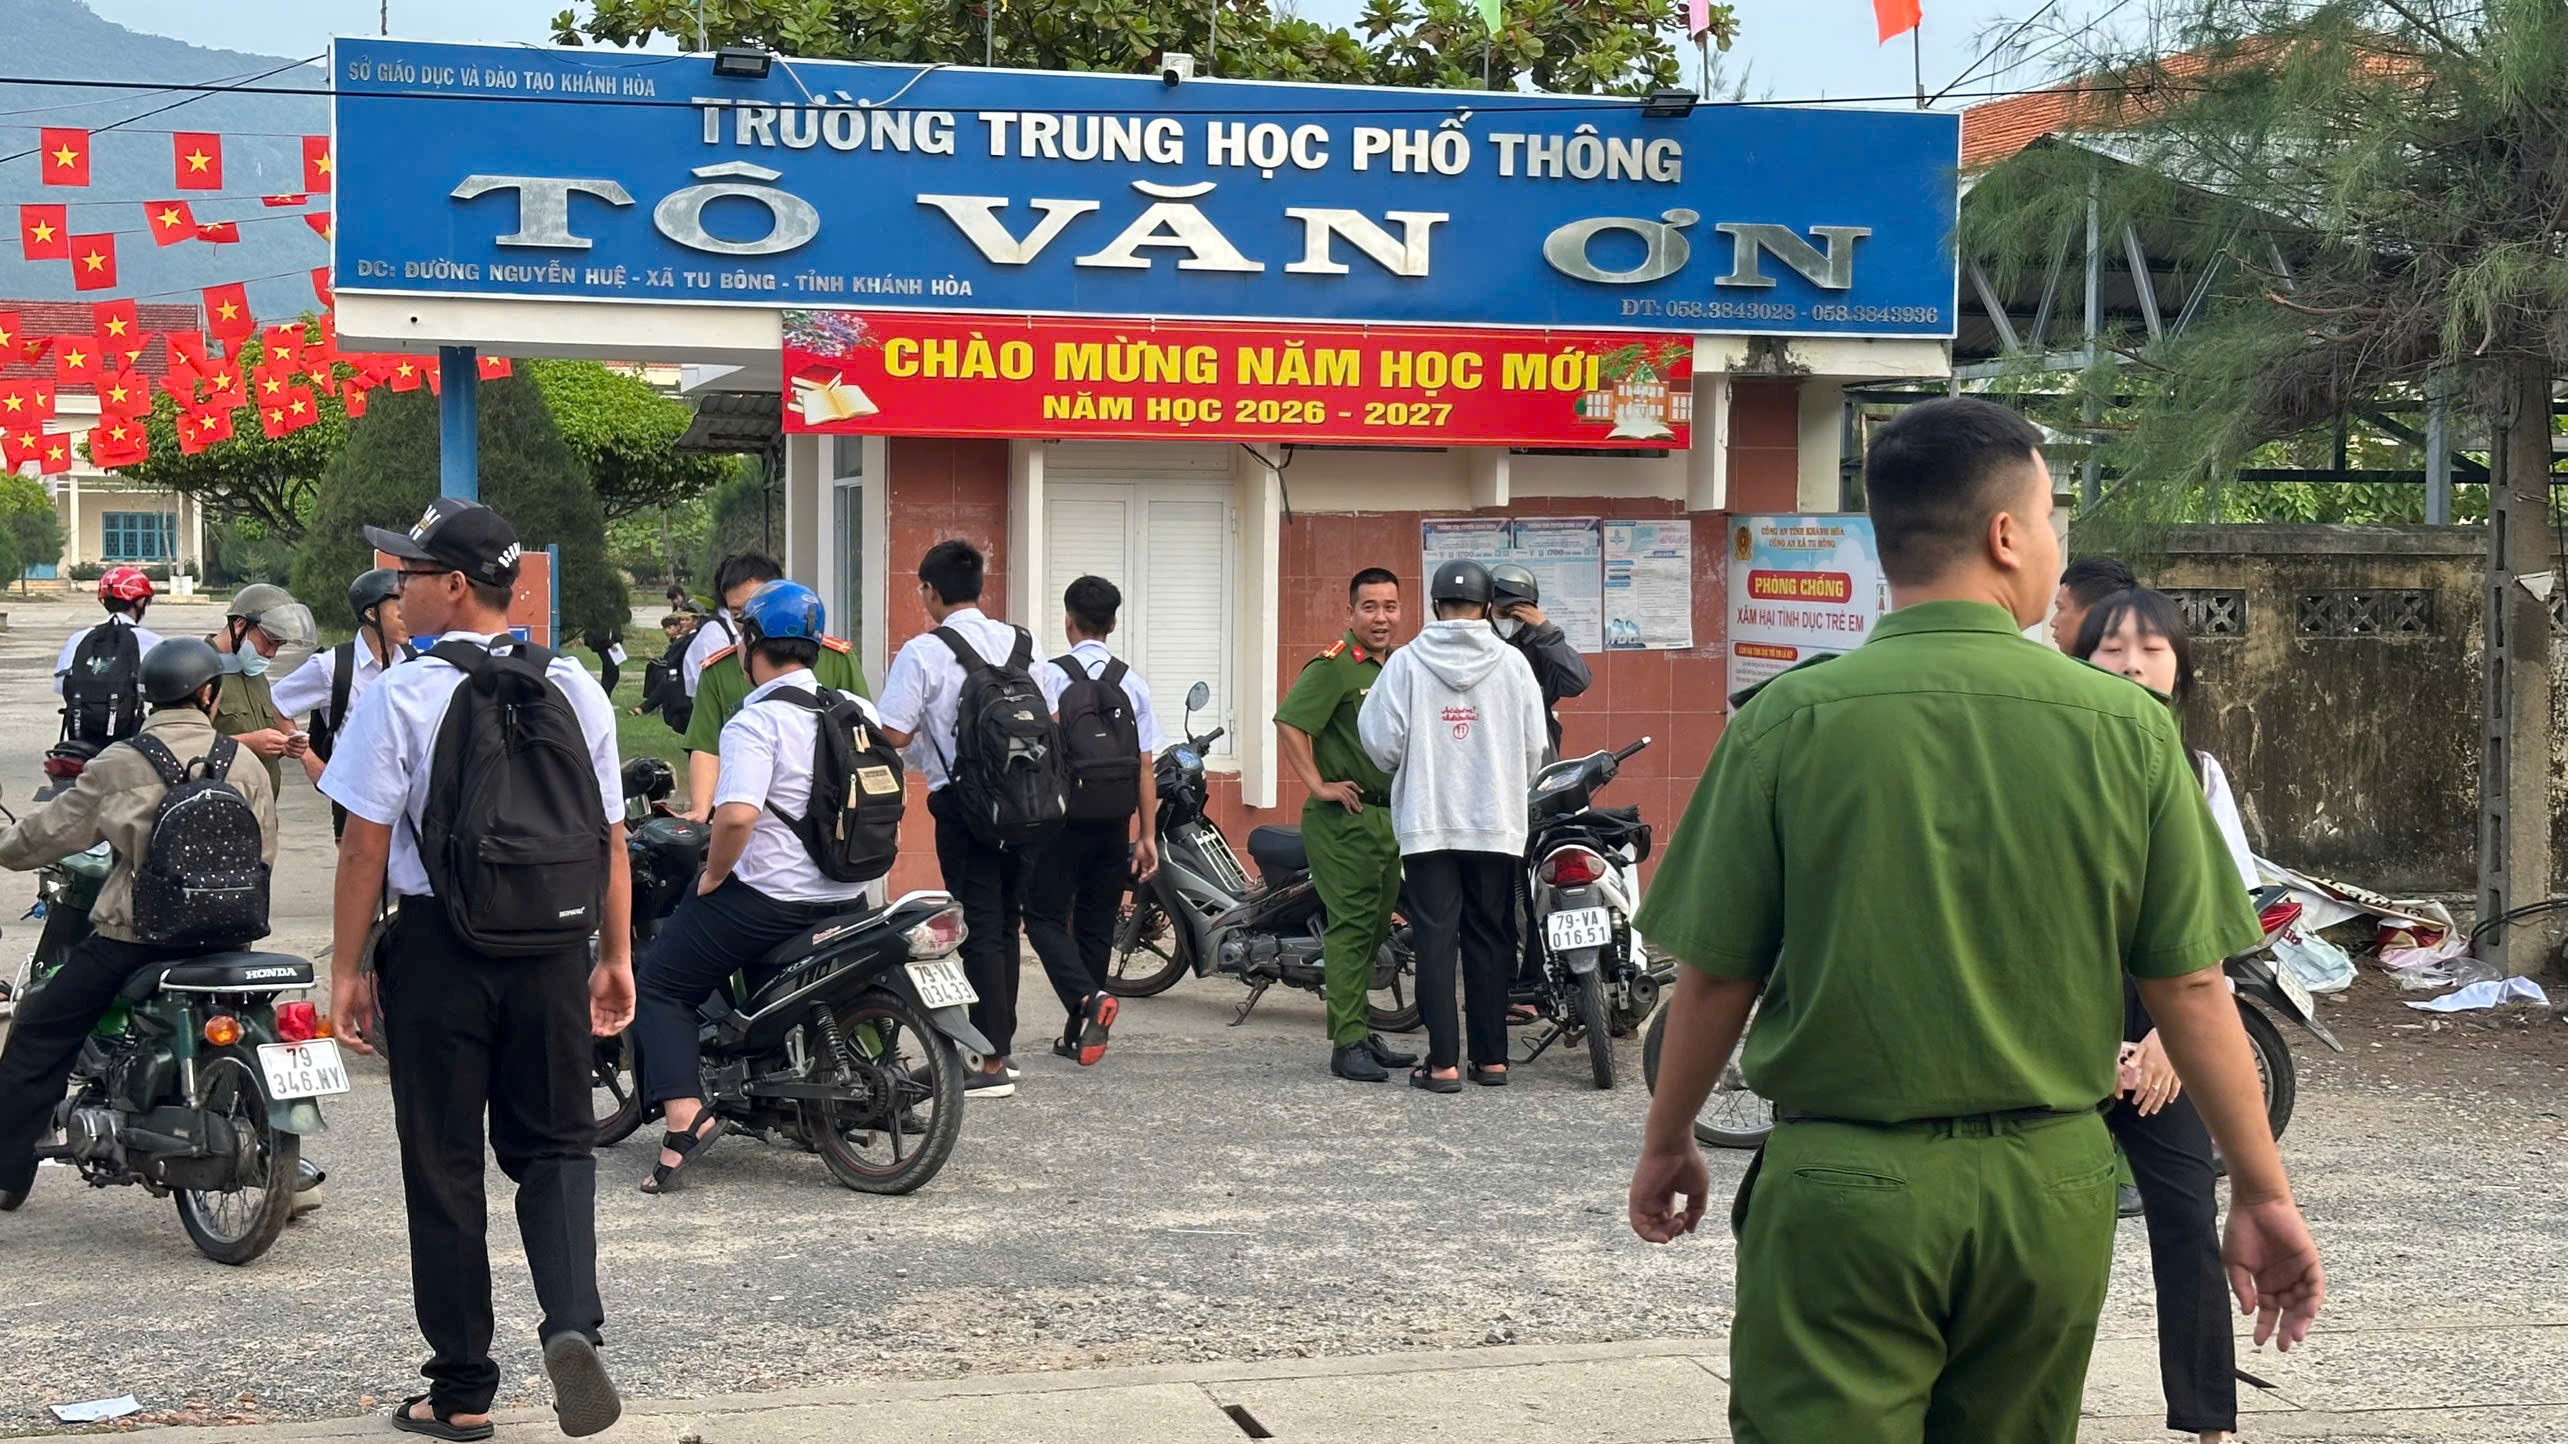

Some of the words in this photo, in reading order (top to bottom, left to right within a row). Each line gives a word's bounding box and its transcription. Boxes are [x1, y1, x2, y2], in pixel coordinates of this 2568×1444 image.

[348, 56, 371, 81] SỞ
[377, 60, 416, 83] GIÁO
[421, 65, 455, 89] DỤC
[461, 64, 480, 87] VÀ
[485, 63, 517, 88] ĐÀO
[523, 71, 555, 94] TẠO
[561, 70, 617, 95] KHÁNH
[623, 73, 656, 97] HÒA
[691, 90, 956, 155] TRƯỜNG
[978, 111, 1185, 165] TRUNG
[1207, 120, 1329, 179] HỌC
[1353, 105, 1472, 175] PHỐ
[1488, 123, 1682, 184] THÔNG
[449, 160, 821, 255] TÔ
[916, 179, 1450, 278] VĂN
[1542, 207, 1873, 289] ƠN
[357, 259, 396, 278] ĐC:
[404, 257, 480, 281] ĐƯỜNG
[489, 259, 576, 284] NGUYỄN
[585, 264, 627, 290] HUỆ
[646, 267, 675, 287] XÃ
[683, 271, 711, 289] TU
[720, 269, 776, 291] BÔNG
[794, 270, 844, 293] TỈNH
[853, 273, 923, 295] KHÁNH
[931, 273, 973, 297] HÒA
[1620, 298, 1662, 316] ĐT:
[1665, 299, 1796, 320] 058.3843028
[1811, 304, 1938, 324] 058.3843936
[884, 331, 1035, 381] CHÀO
[1055, 334, 1218, 385] MỪNG
[1237, 339, 1361, 387] NĂM
[1380, 349, 1484, 398] HỌC
[1501, 346, 1600, 392] MỚI
[1042, 391, 1133, 421] NĂM
[1146, 397, 1223, 428] HỌC
[1234, 399, 1326, 425] 2026
[1363, 401, 1454, 427] 2027
[1754, 574, 1797, 595] PHÒNG
[1800, 573, 1844, 597] CHỐNG
[1736, 604, 1757, 625] XÂM
[1760, 607, 1775, 630] HẠI
[1778, 605, 1800, 627] TÌNH
[1802, 611, 1823, 632] DỤC
[1826, 610, 1846, 631] TRẺ
[1848, 614, 1864, 632] EM
[1556, 911, 1599, 930] 79-VA
[1552, 926, 1606, 948] 016.51
[244, 967, 298, 980] HONDA
[921, 982, 973, 1004] 034.33
[286, 1046, 313, 1069] 79
